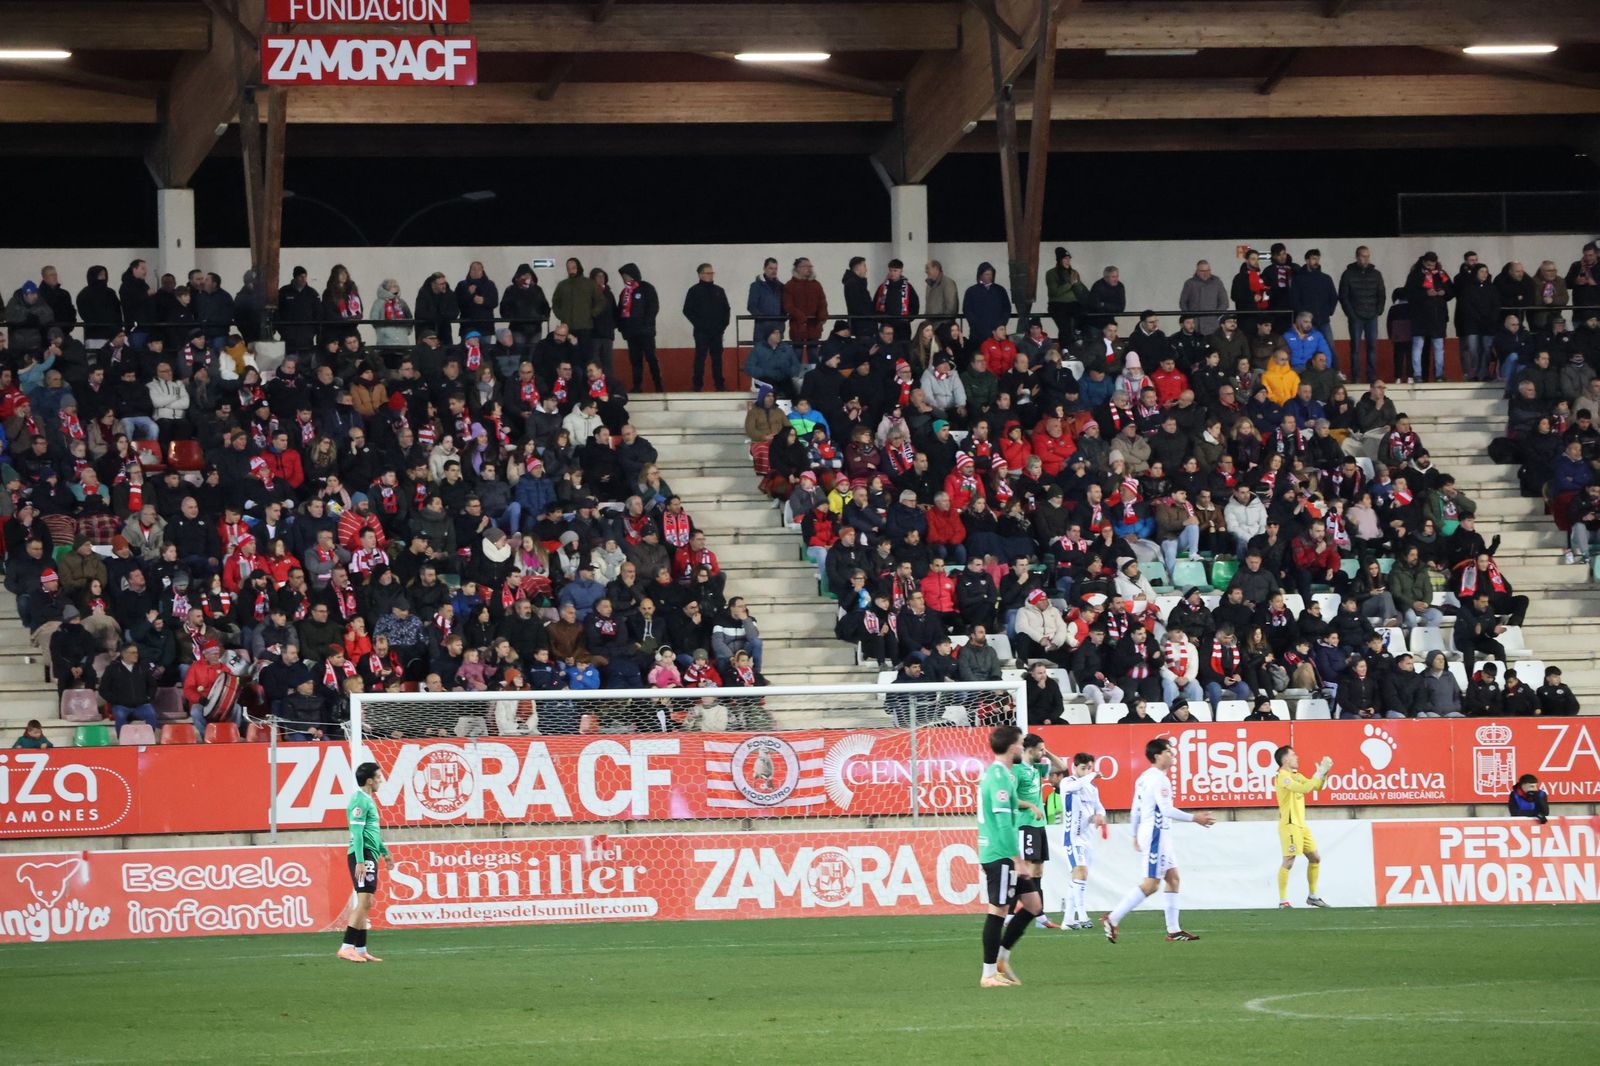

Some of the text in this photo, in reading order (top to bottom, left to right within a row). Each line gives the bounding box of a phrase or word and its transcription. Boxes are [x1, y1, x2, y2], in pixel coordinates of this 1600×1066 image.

[267, 39, 471, 81] ZAMORACF
[746, 740, 781, 750] FONDO
[1178, 728, 1279, 775] fisio
[1537, 724, 1600, 772] ZA
[268, 738, 681, 824] ZAMORA CF
[846, 758, 985, 785] CENTRO
[742, 786, 791, 802] MODORRO
[907, 784, 979, 810] ROB
[1180, 792, 1264, 803] POLICLÍNICA
[1330, 789, 1446, 801] PODOLOGÍA Y BIOMECÁNICA
[1026, 835, 1033, 846] 2
[1440, 825, 1600, 859] PERSiAN
[122, 856, 312, 893] Escuela
[388, 853, 648, 901] Sumiller
[429, 850, 522, 870] bodegas
[694, 843, 990, 911] ZAMORA C
[1385, 863, 1600, 905] ZAMORAN
[127, 895, 314, 934] infantil
[390, 903, 649, 921] www.bodegasdelsumiller.com
